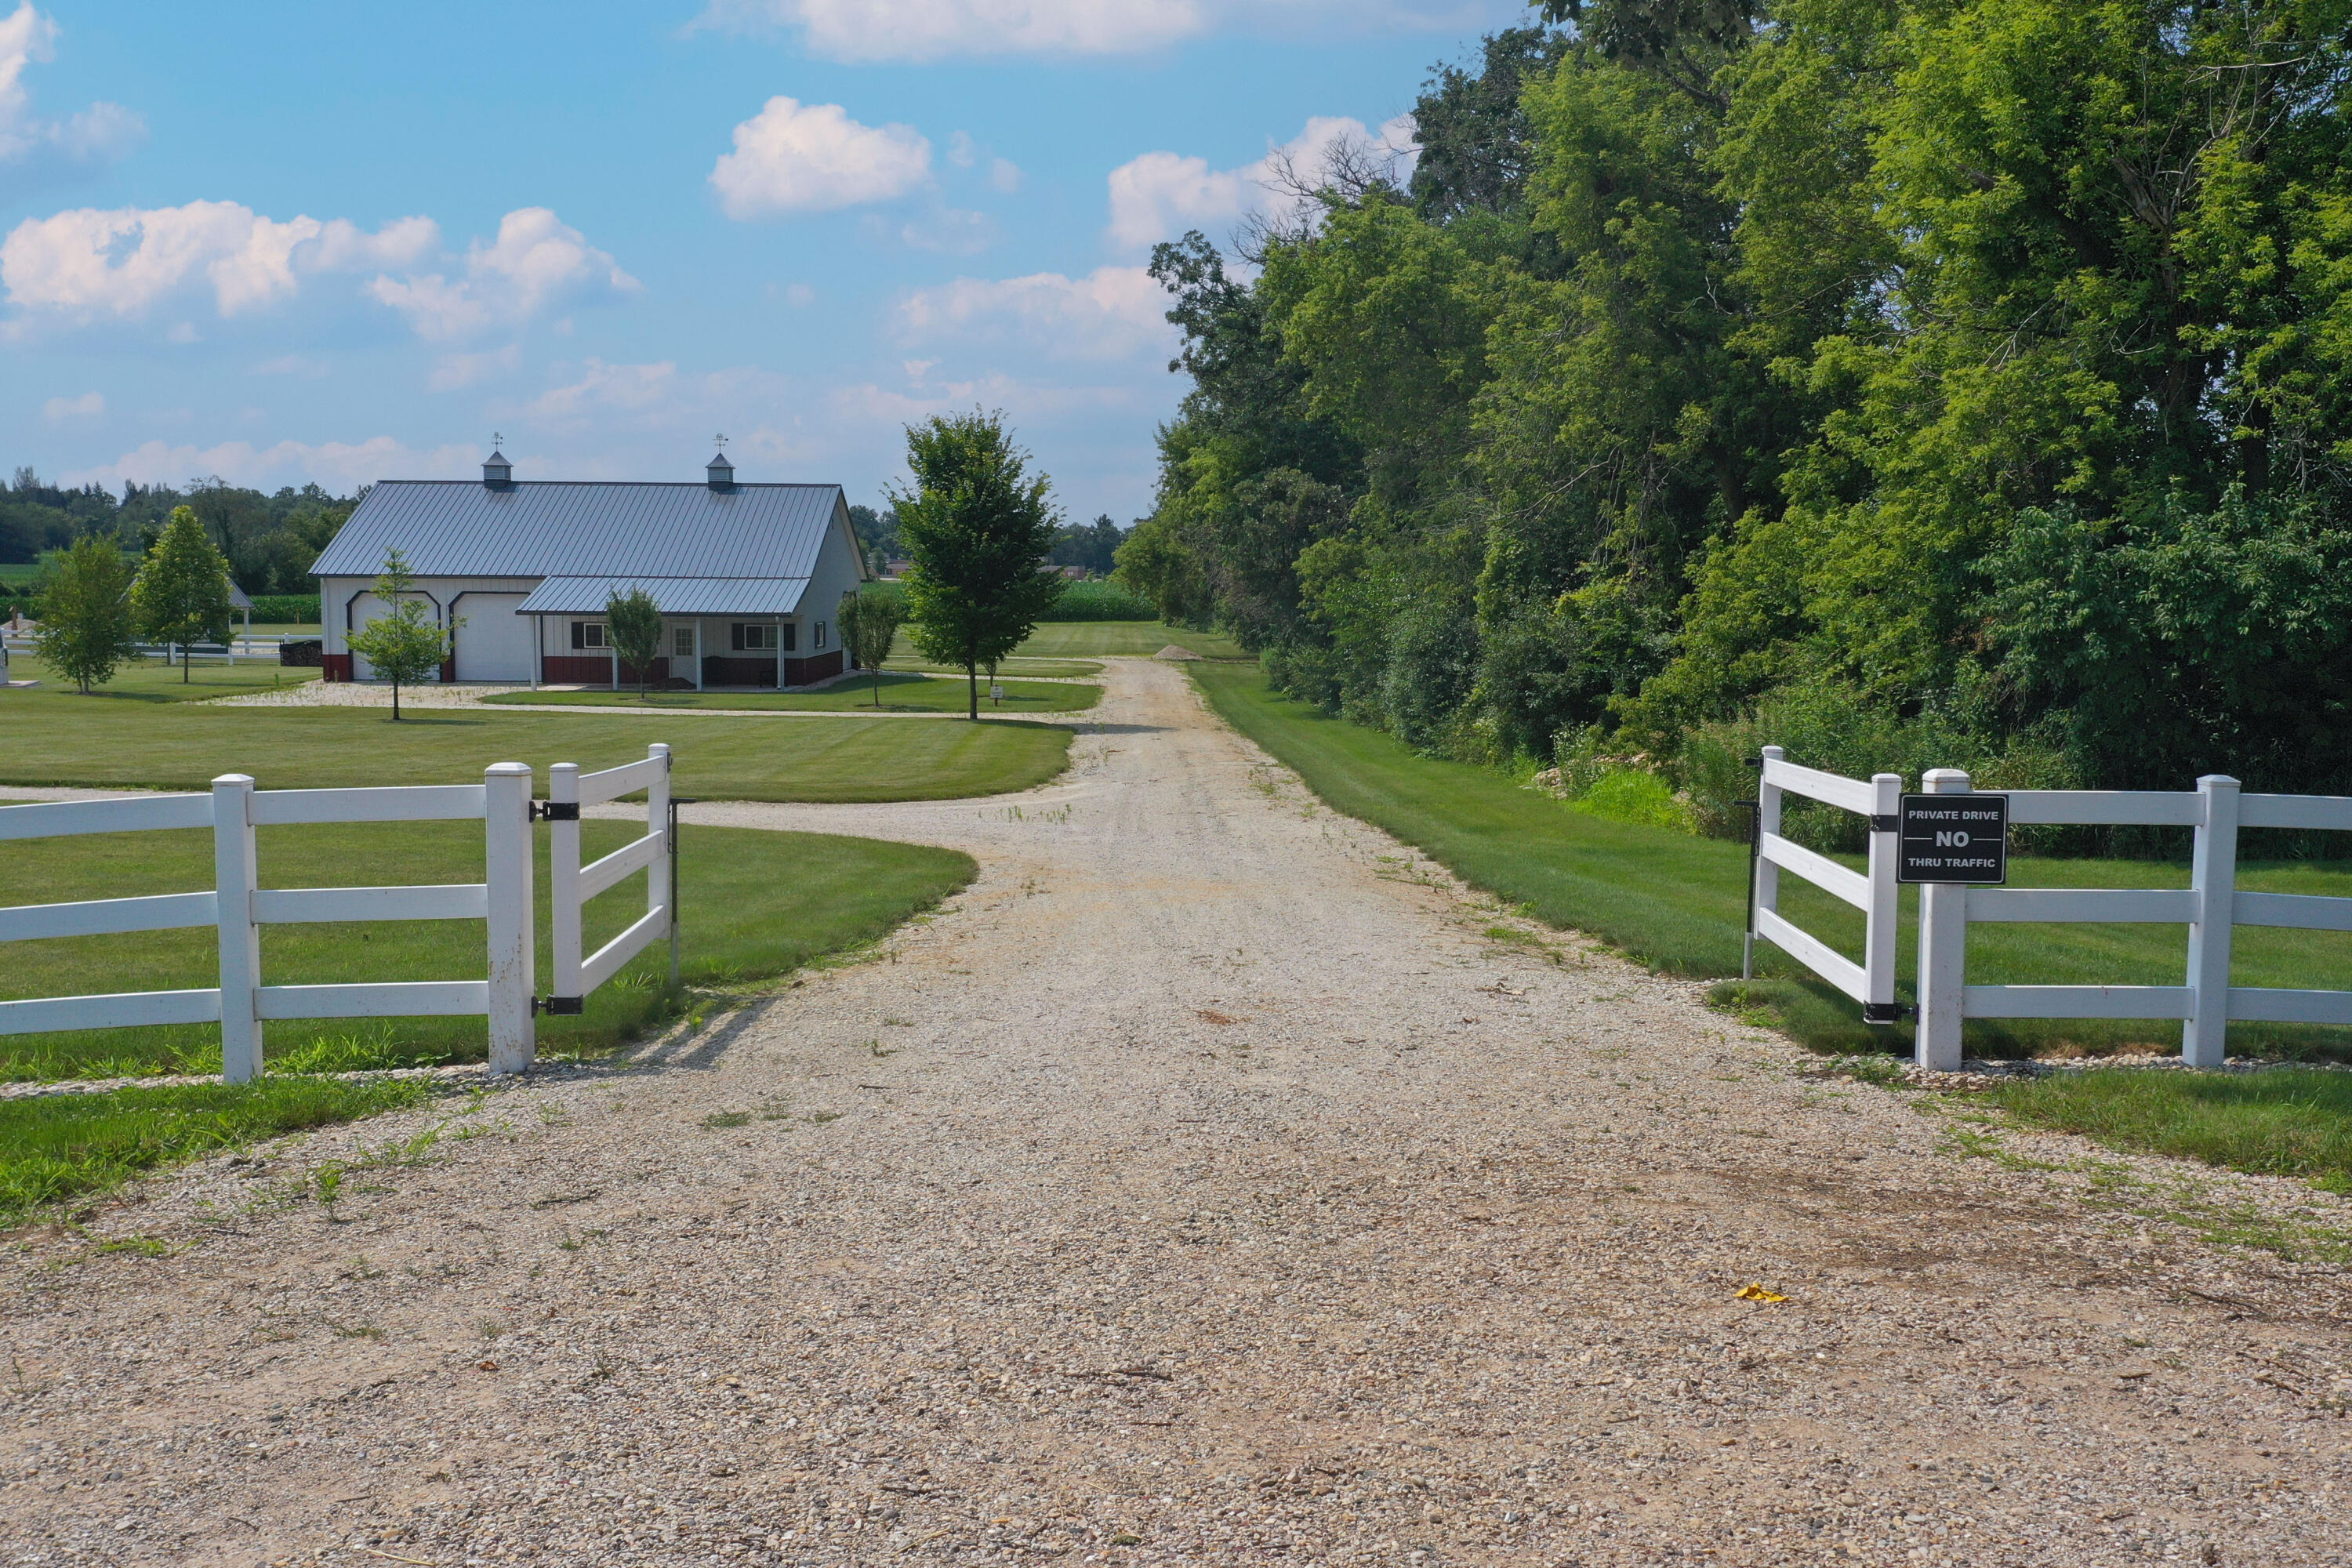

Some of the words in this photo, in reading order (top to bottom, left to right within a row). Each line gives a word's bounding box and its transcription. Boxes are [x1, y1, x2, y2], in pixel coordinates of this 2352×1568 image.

[1908, 811, 1959, 820] PRIVATE
[1962, 811, 1999, 820] DRIVE
[1936, 831, 1969, 848] NO
[1907, 858, 1942, 867] THRU
[1944, 858, 1996, 868] TRAFFIC
